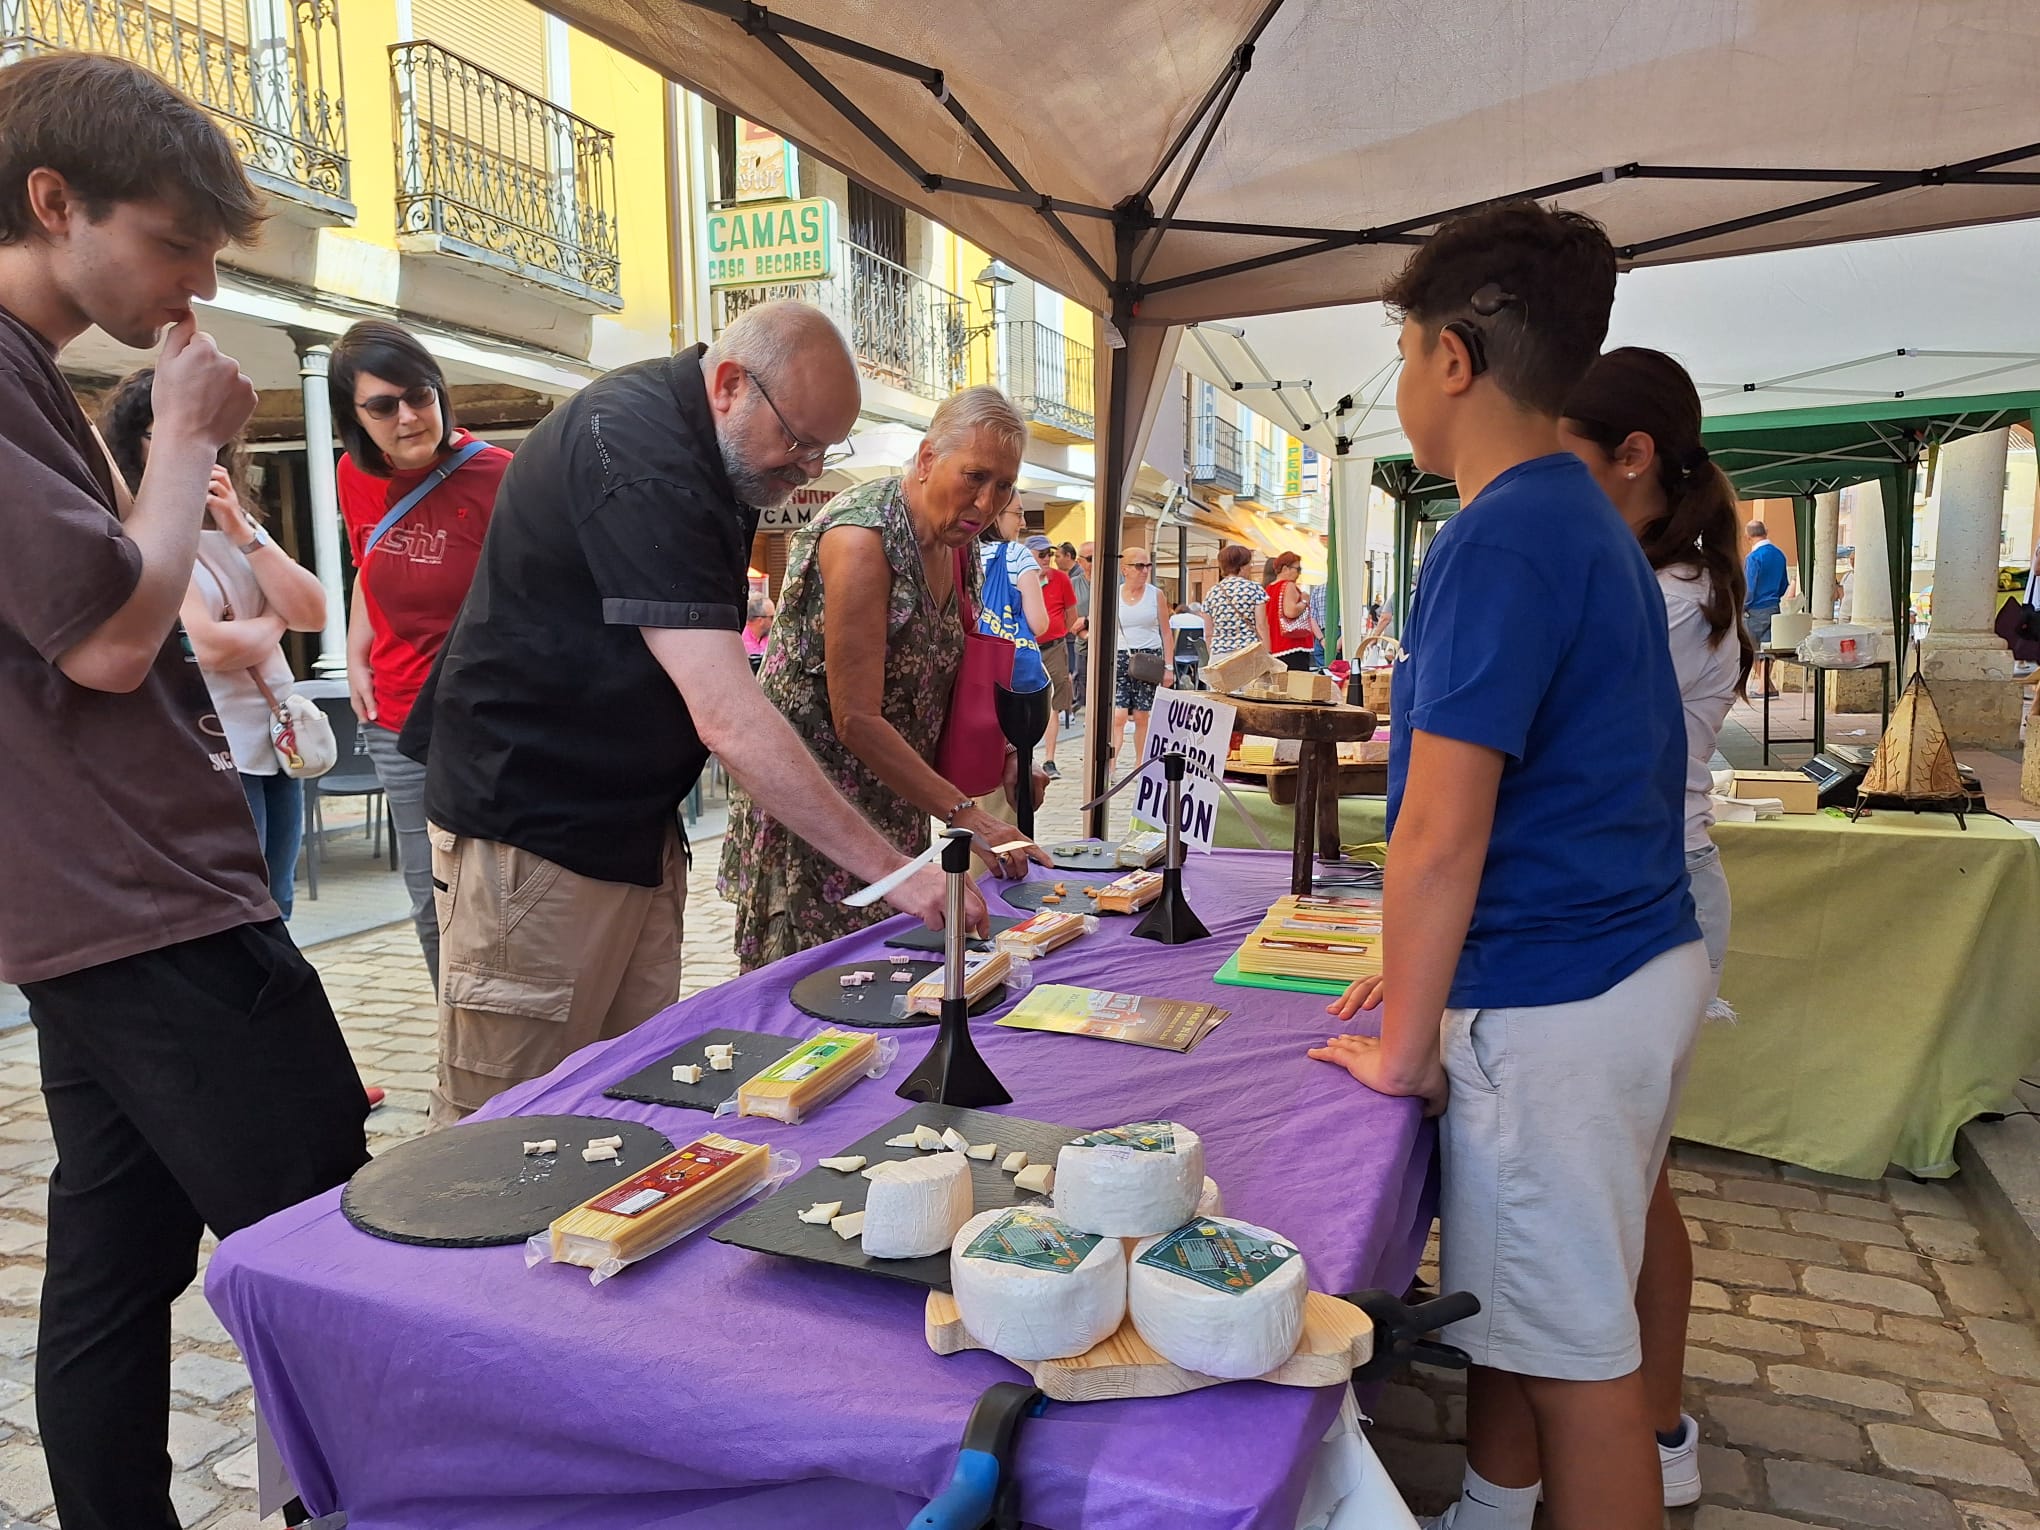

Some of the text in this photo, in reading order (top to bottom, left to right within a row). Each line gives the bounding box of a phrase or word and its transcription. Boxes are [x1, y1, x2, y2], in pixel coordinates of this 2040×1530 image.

[709, 206, 820, 253] CAMAS
[709, 250, 822, 280] CASA BECARES
[1168, 698, 1214, 736] QUESO
[1150, 734, 1169, 764] DE
